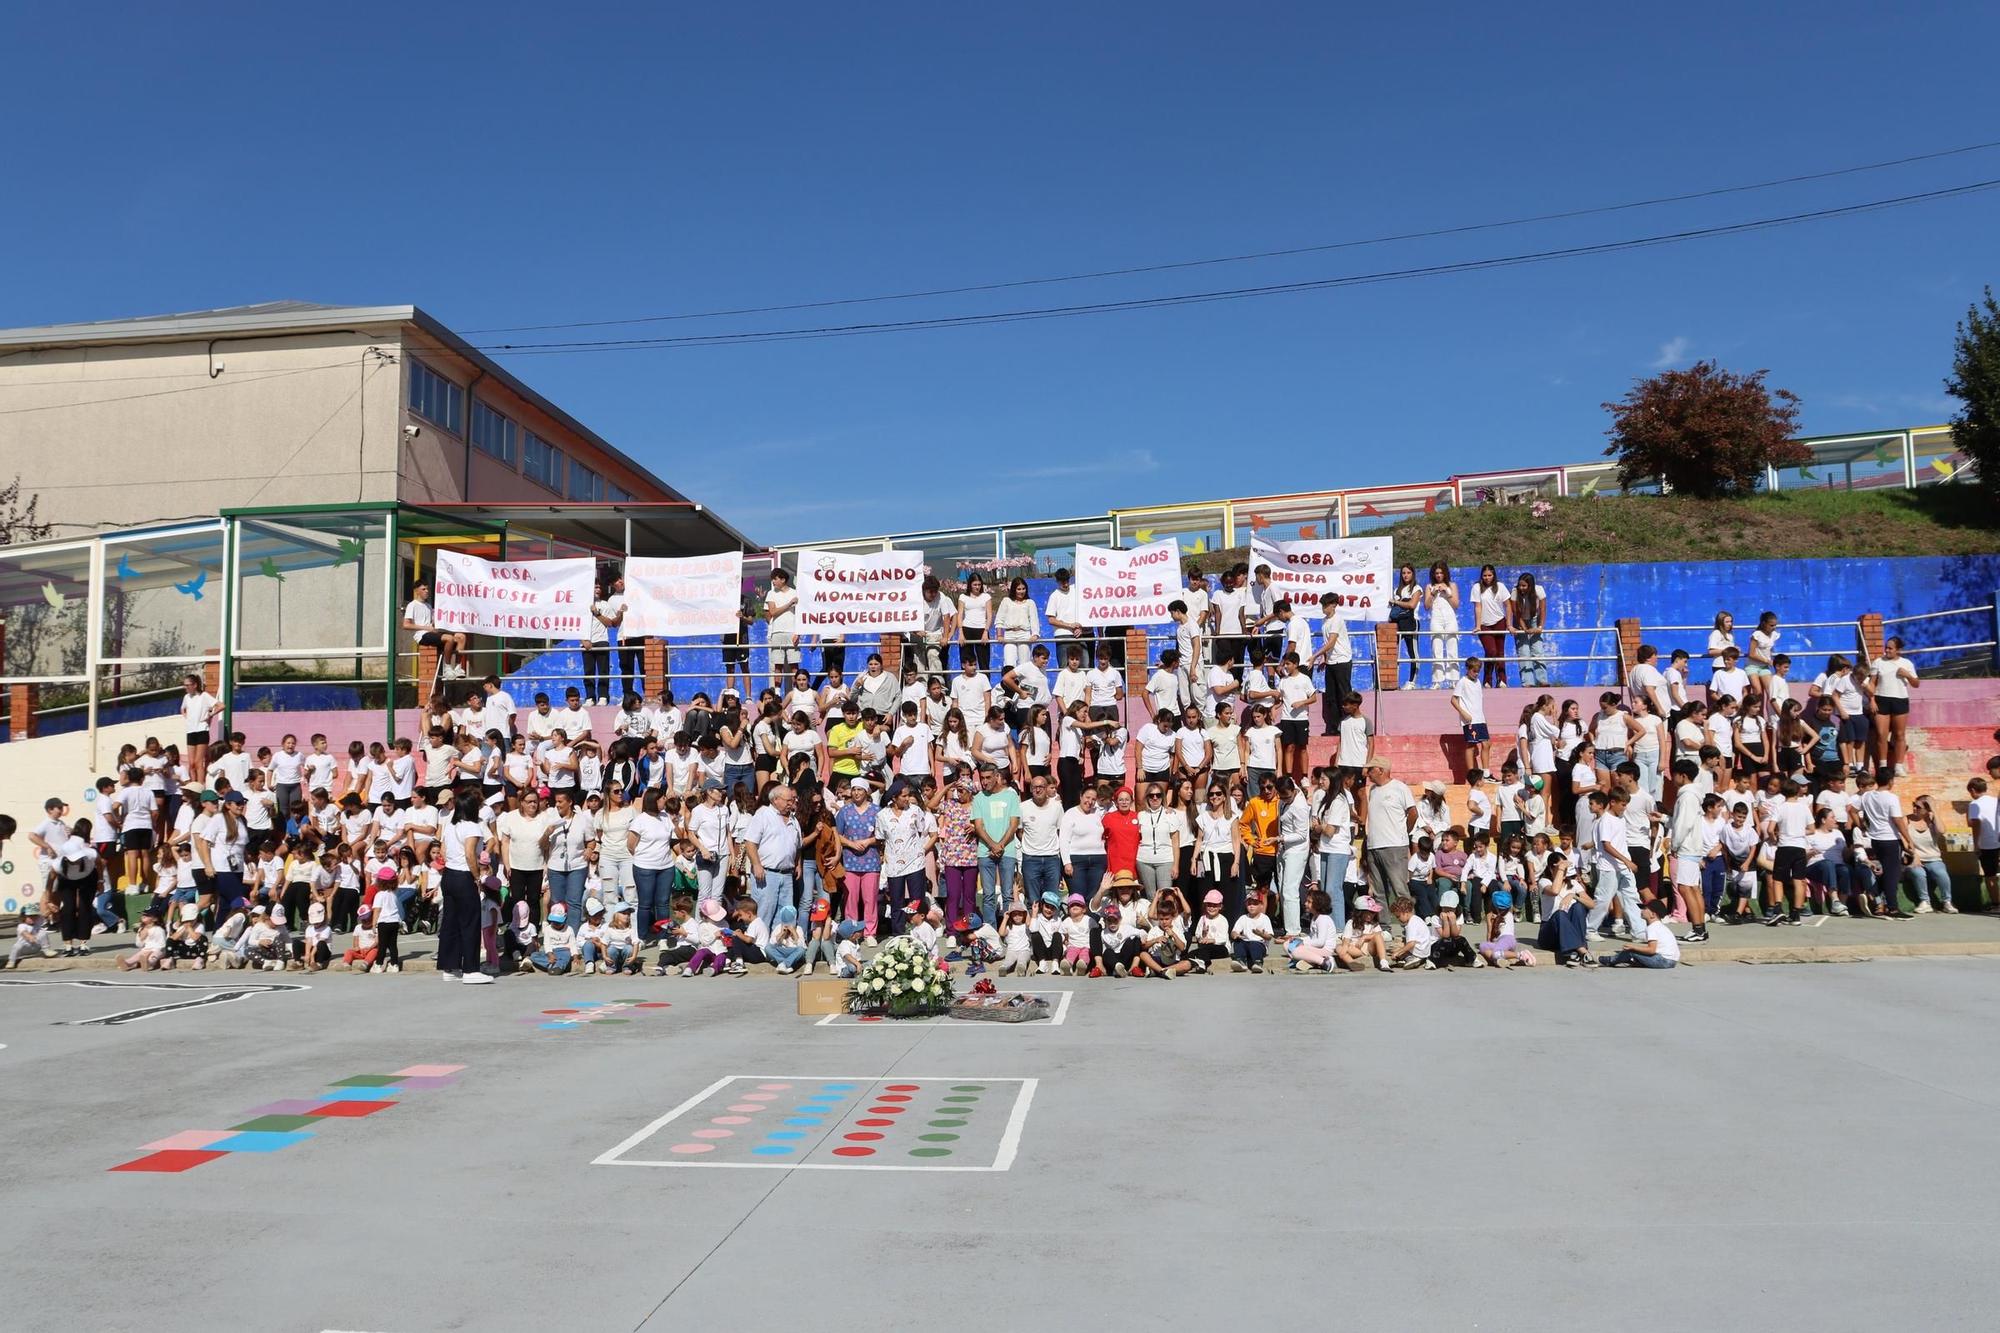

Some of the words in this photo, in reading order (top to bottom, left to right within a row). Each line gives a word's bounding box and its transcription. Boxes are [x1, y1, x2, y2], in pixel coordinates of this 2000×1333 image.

[1089, 556, 1108, 566] 46
[1128, 549, 1170, 568] ANOS
[1287, 553, 1335, 566] ROSA
[814, 568, 916, 583] COCIÑANDO
[1118, 570, 1137, 581] DE
[1342, 573, 1375, 585] QUE
[554, 589, 575, 604] DE
[814, 590, 907, 602] MOMENTOS
[1082, 584, 1138, 600] SABOR
[1152, 582, 1163, 597] E
[801, 609, 919, 626] INESQUECIBLES
[1088, 603, 1167, 619] AGARIMO
